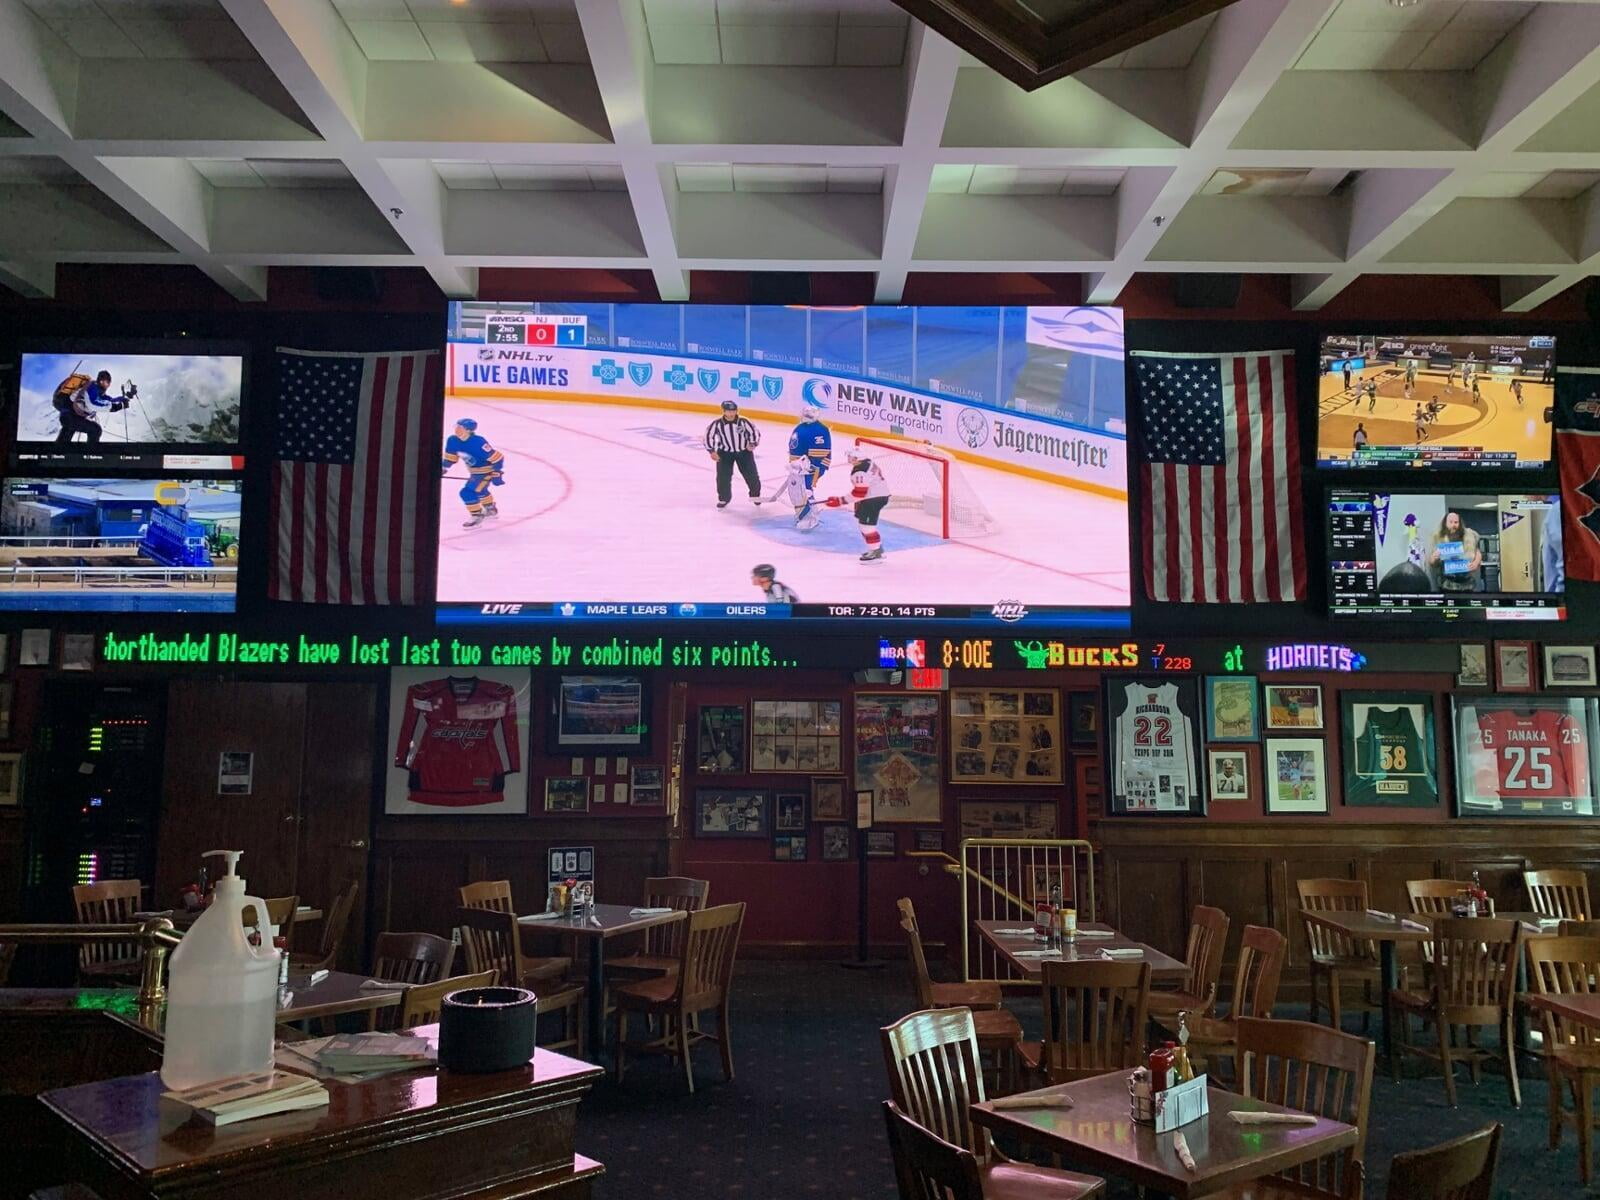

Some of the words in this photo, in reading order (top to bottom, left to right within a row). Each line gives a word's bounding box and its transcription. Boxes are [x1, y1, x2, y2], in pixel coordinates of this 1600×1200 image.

[535, 316, 548, 324] NJ
[562, 316, 581, 324] BUF
[498, 325, 515, 333] 2ND
[536, 328, 547, 341] 0
[567, 329, 575, 341] 1
[495, 333, 519, 342] 7:55
[498, 350, 553, 362] NHL.TV
[464, 364, 500, 383] LIVE
[507, 366, 568, 387] GAMES
[838, 383, 883, 406] NEW
[890, 393, 942, 420] WAVE
[837, 400, 877, 421] Energy
[879, 408, 943, 434] Corporation
[480, 604, 523, 615] LIVE
[587, 605, 628, 615] MAPLE
[632, 605, 667, 615] LEAFS
[726, 605, 767, 616] OILERS
[828, 606, 856, 616] TOR:
[859, 606, 894, 617] 7-2-0,
[897, 607, 911, 616] 14
[914, 606, 936, 616] PTS
[991, 604, 1029, 615] NHL
[218, 633, 289, 663] Blazers
[299, 634, 340, 664] have
[351, 635, 389, 664] lost
[402, 636, 440, 665] last
[451, 639, 482, 666] two
[491, 643, 542, 666] games
[552, 637, 571, 666] by
[582, 637, 663, 666] combined
[672, 640, 702, 666] six
[879, 647, 905, 659] NBA
[942, 640, 993, 669] 8:00E
[1152, 644, 1165, 656] -7
[1151, 657, 1160, 669] T
[1164, 657, 1192, 670] 228
[1224, 645, 1243, 671] at
[1266, 645, 1353, 671] HORNETS
[1134, 715, 1173, 747] 22
[1474, 729, 1493, 744] 25
[1506, 729, 1547, 742] TANAKA
[1561, 728, 1581, 744] 25
[1380, 745, 1407, 770] 58
[1504, 746, 1553, 789] 25
